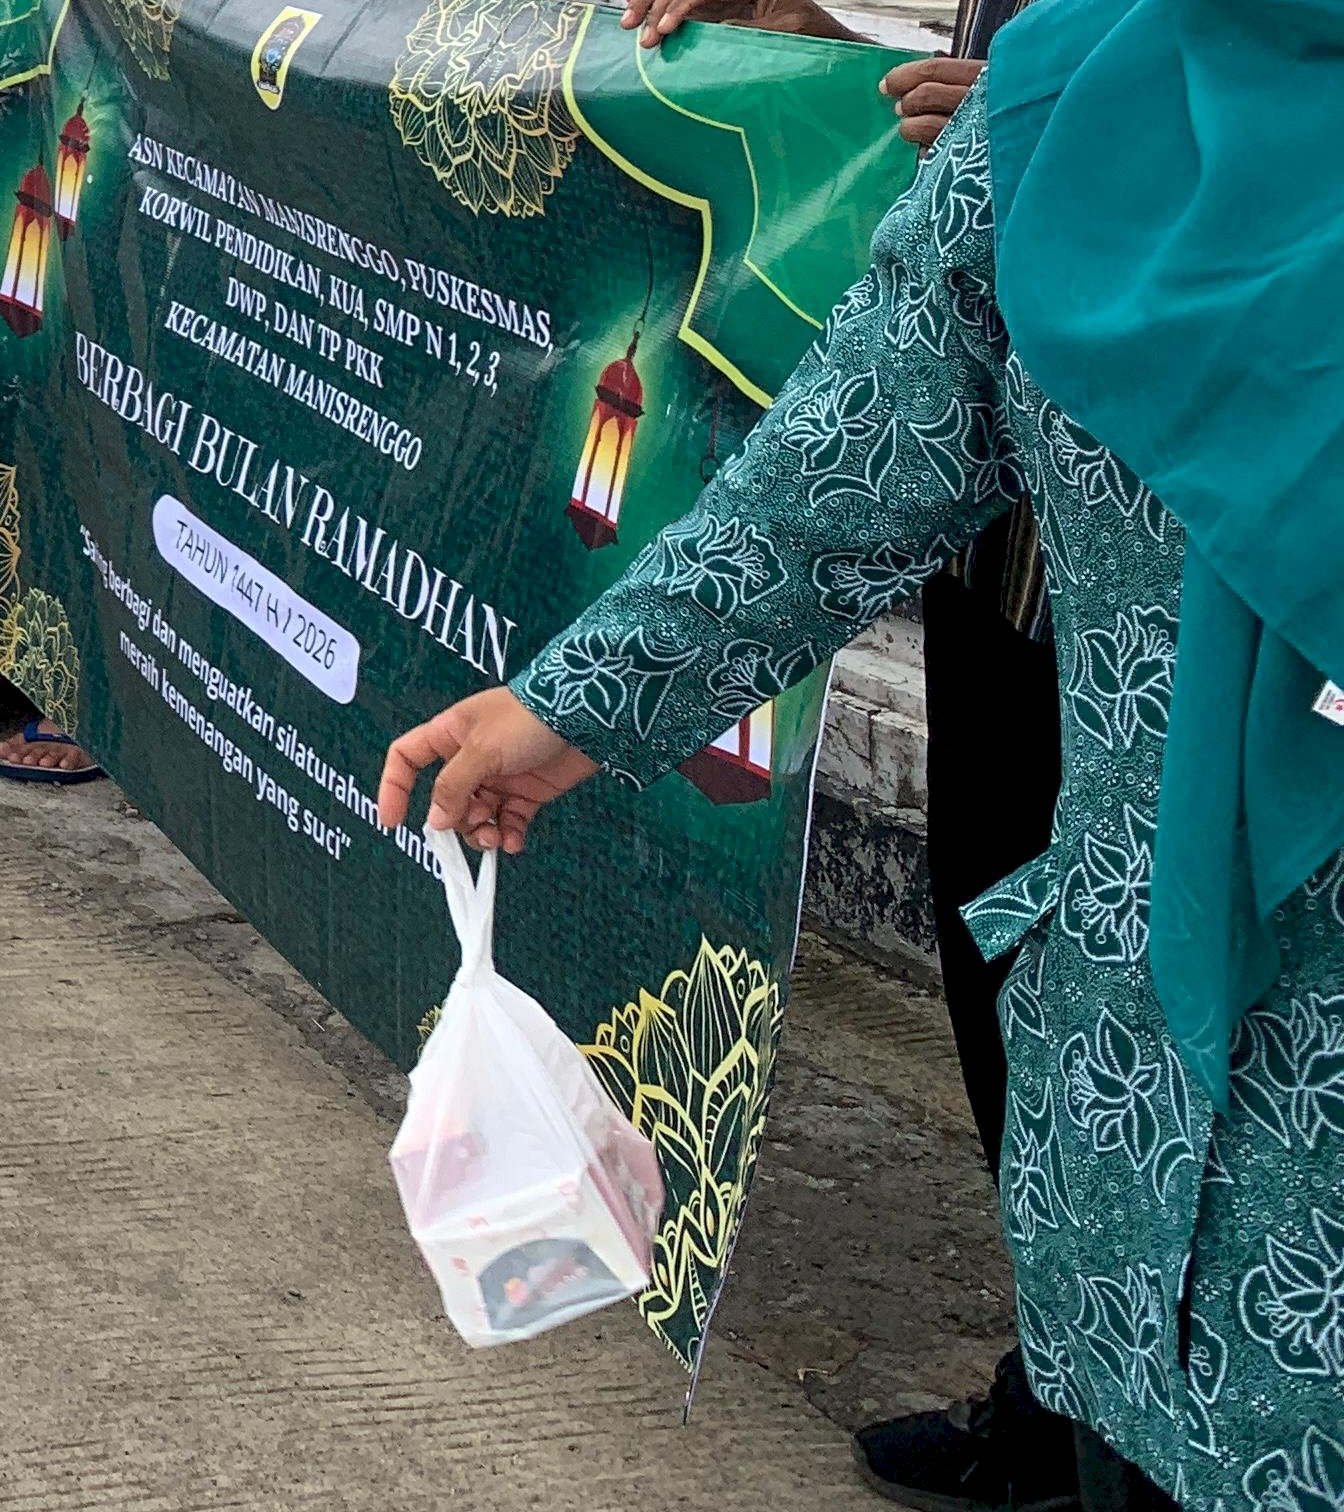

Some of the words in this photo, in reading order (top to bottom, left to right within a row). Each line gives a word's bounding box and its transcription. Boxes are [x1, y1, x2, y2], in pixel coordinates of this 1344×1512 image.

[128, 133, 163, 171] ASN
[166, 146, 262, 218] KECAMATAN
[258, 194, 407, 292] MANISRENGGO,
[404, 258, 555, 359] PUSKESMAS,
[138, 185, 212, 243] KORWIL
[214, 219, 325, 307] PENDIDIKAN,
[329, 274, 369, 331] KUA,
[373, 298, 421, 347] SMP
[424, 321, 443, 360] N
[274, 301, 315, 350] DAN
[317, 323, 342, 362] TP
[344, 338, 385, 389] PKK
[164, 300, 286, 388] KECAMATAN
[282, 363, 422, 471] MANISRENGGO
[75, 331, 192, 456] BERBAGI
[187, 413, 310, 529] BULAN
[301, 484, 518, 682] RAMADHAN
[176, 519, 229, 585] TAHUN
[230, 564, 264, 612] 1447
[266, 596, 279, 628] H
[292, 613, 337, 670] 2026
[108, 560, 152, 632] berbagi
[152, 609, 176, 654] dan
[178, 638, 275, 741] menguatkan
[275, 724, 388, 836] silaturahm
[120, 630, 159, 691] meraih
[161, 668, 253, 784] kemenangan
[255, 766, 300, 833] yang
[302, 808, 352, 861] suci"
